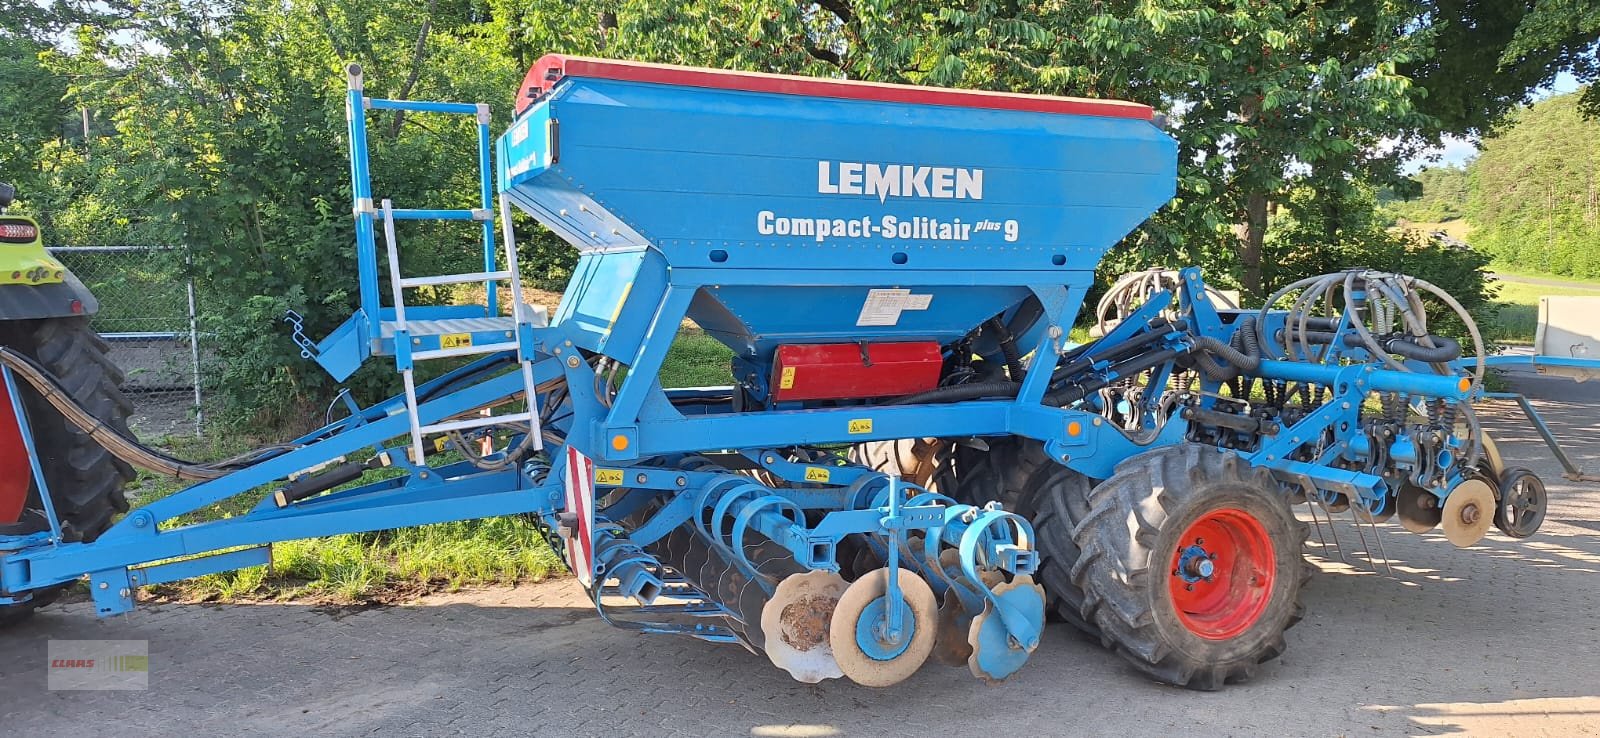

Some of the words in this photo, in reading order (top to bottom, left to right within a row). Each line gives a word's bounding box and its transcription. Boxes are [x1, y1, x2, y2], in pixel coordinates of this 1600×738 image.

[818, 161, 983, 205] LEMKEN
[757, 210, 971, 242] Compact-Solitair
[974, 219, 1001, 232] plus
[1004, 219, 1019, 242] 9
